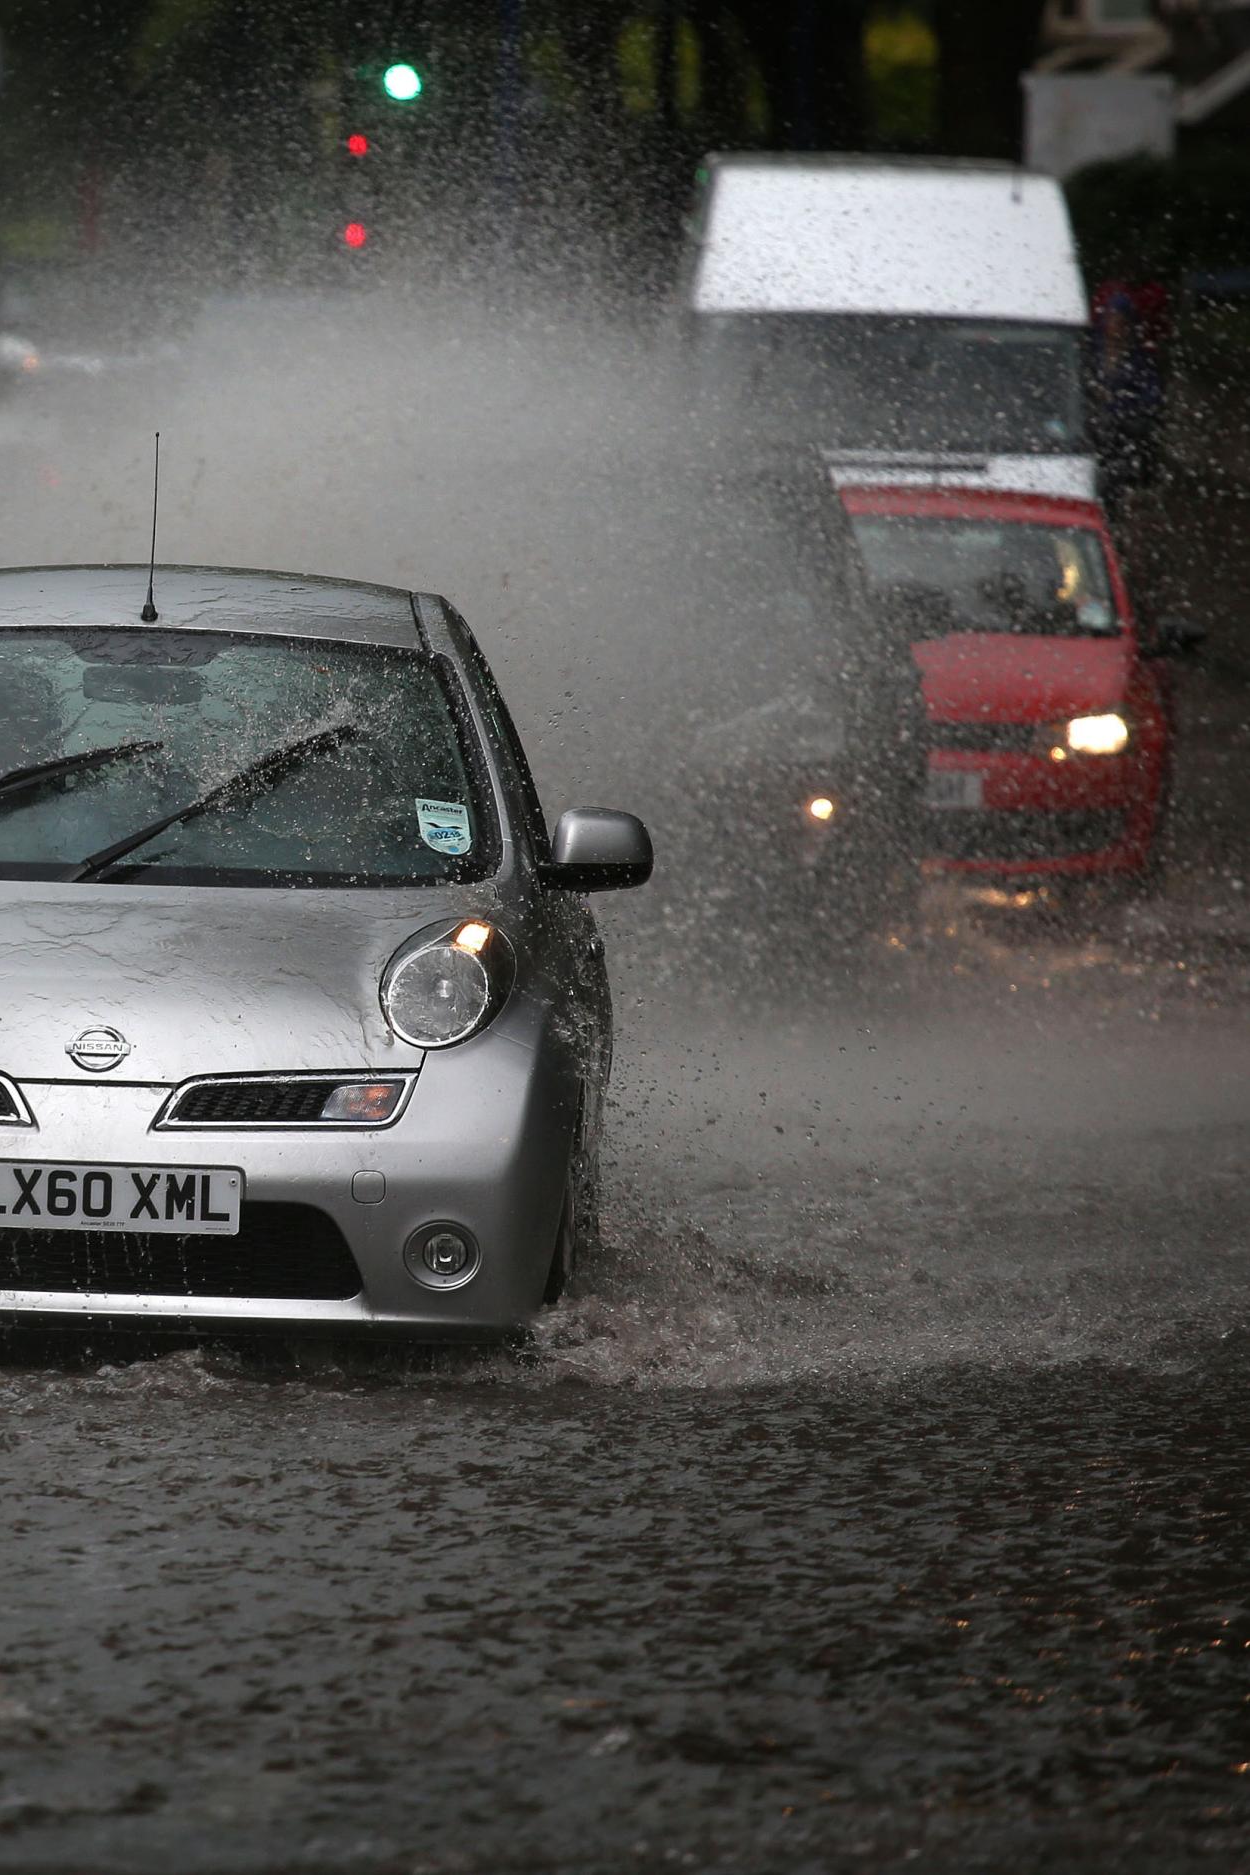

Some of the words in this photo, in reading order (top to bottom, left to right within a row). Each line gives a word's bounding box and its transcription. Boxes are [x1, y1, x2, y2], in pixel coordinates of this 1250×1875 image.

[422, 803, 462, 814] Ancaster
[72, 1042, 123, 1052] NISSAN
[129, 1172, 230, 1222] XML
